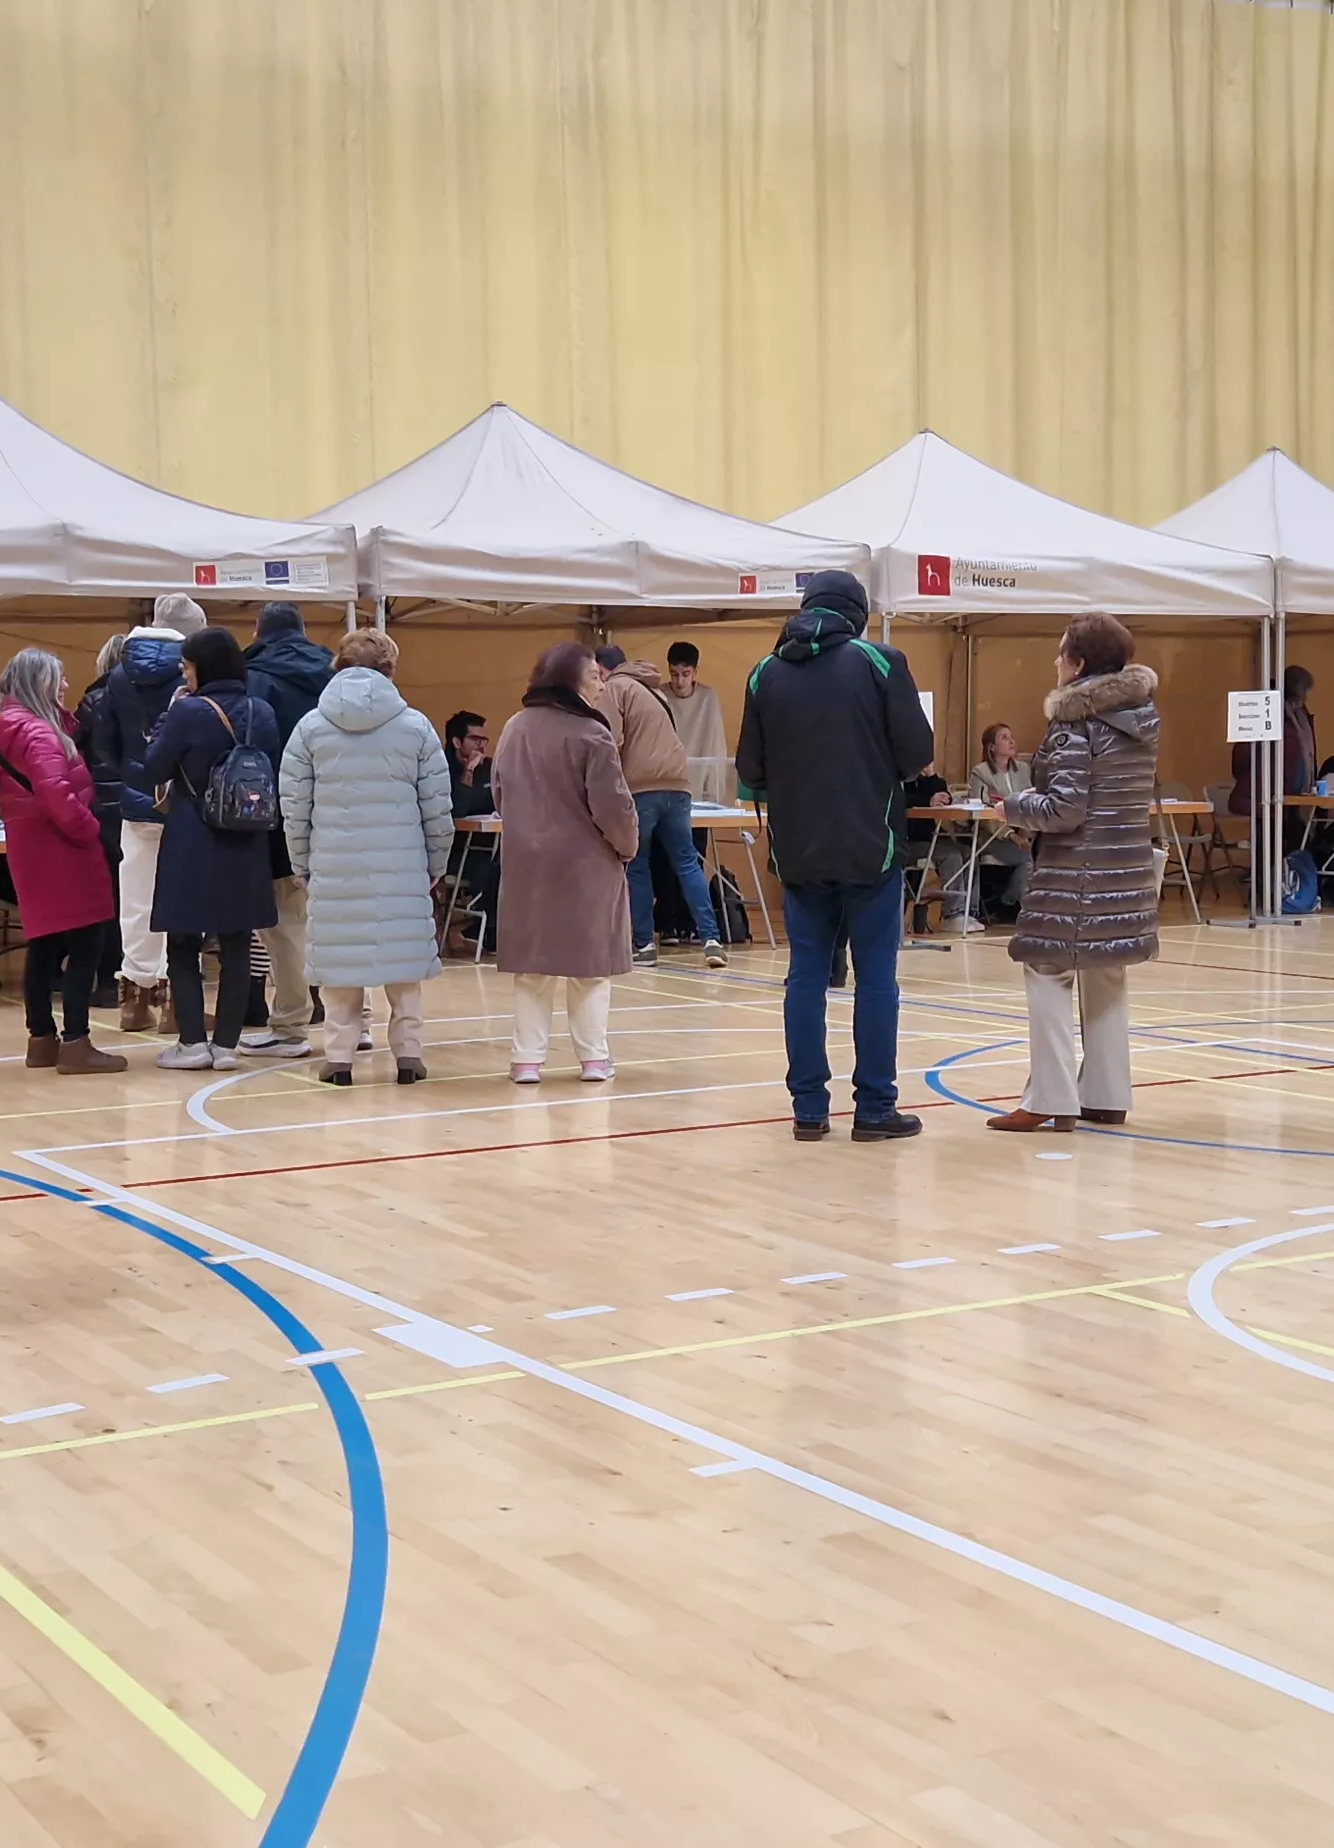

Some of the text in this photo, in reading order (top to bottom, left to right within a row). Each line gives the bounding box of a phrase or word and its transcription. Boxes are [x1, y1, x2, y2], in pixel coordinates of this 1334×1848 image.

[954, 573, 1016, 588] de Huesca
[1265, 696, 1271, 706] 5
[1265, 720, 1272, 731] B
